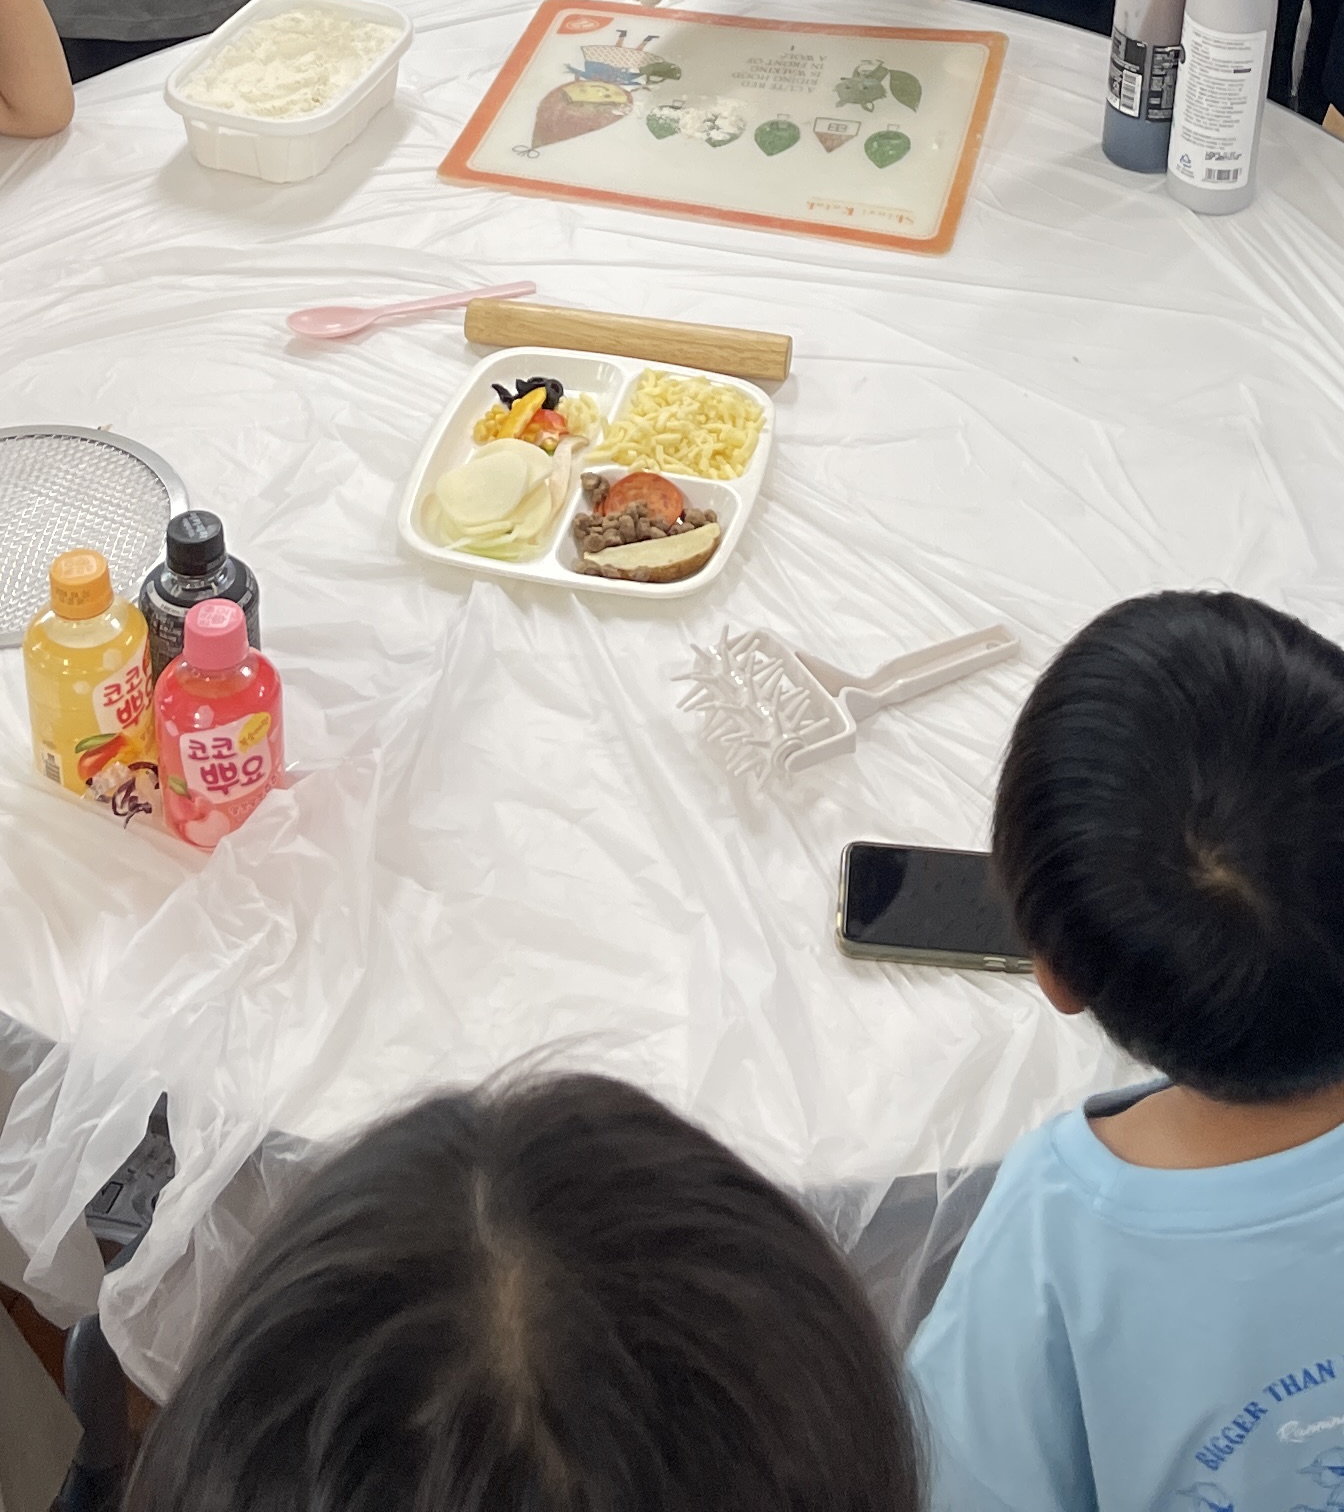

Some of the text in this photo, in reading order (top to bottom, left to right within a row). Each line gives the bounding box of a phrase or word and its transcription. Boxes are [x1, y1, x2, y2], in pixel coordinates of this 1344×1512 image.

[103, 665, 143, 707] 코코
[188, 737, 237, 761] 코코
[200, 755, 265, 795] 뿌요
[1194, 1401, 1268, 1471] BIGGER
[1262, 1359, 1337, 1402] THAN
